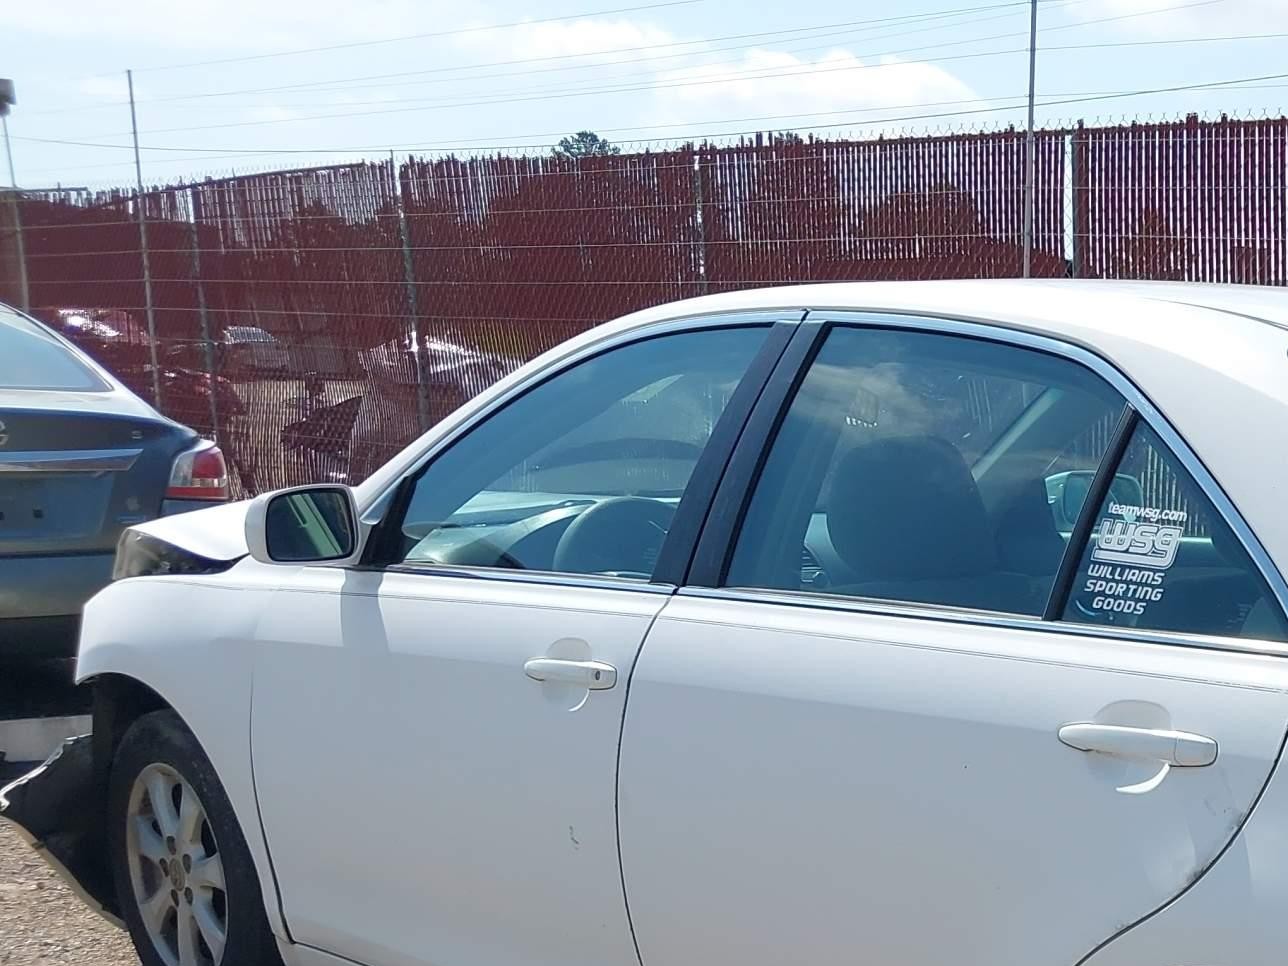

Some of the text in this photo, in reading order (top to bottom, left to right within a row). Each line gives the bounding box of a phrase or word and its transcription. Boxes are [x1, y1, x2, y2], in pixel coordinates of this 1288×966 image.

[1108, 501, 1188, 522] teamwsg.com
[1087, 564, 1165, 585] WILLIAMS
[1084, 579, 1164, 601] SPORTING
[1092, 596, 1147, 615] GOODS
